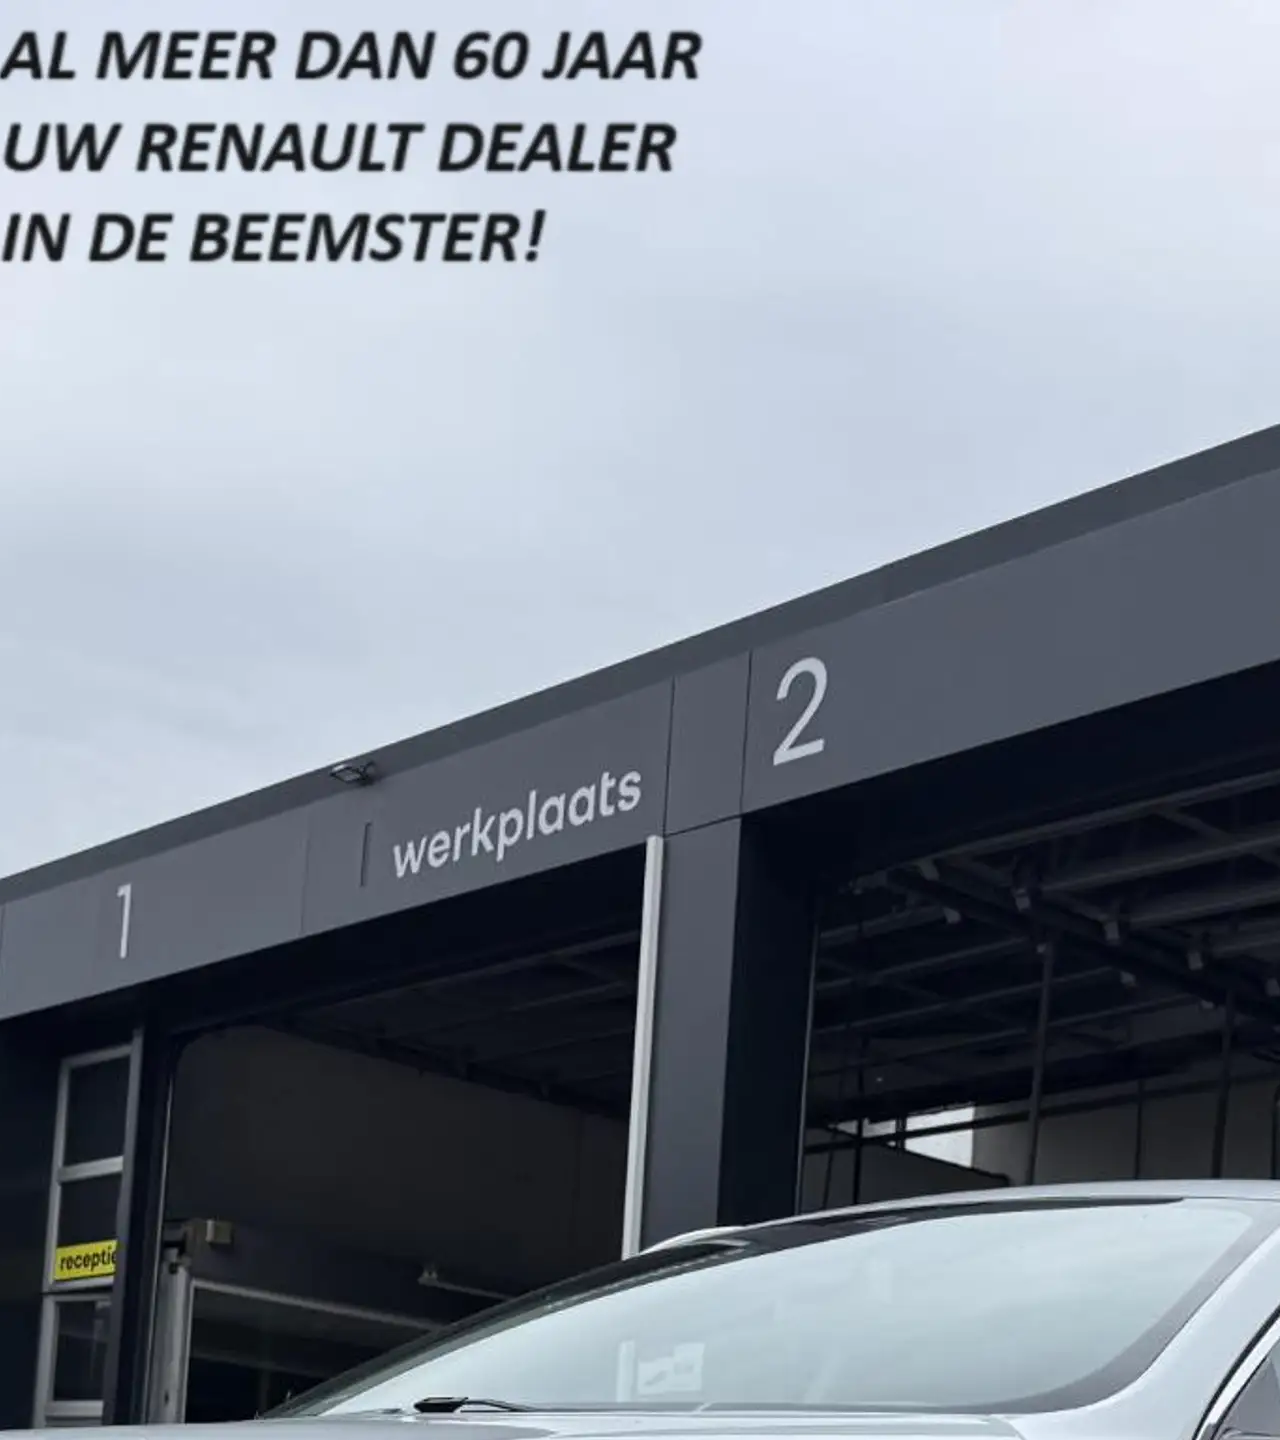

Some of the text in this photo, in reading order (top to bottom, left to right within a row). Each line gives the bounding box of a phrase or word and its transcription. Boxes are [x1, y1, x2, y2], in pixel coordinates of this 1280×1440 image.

[772, 656, 828, 767] 2
[392, 767, 643, 879] werkplaats
[116, 883, 133, 959] 1
